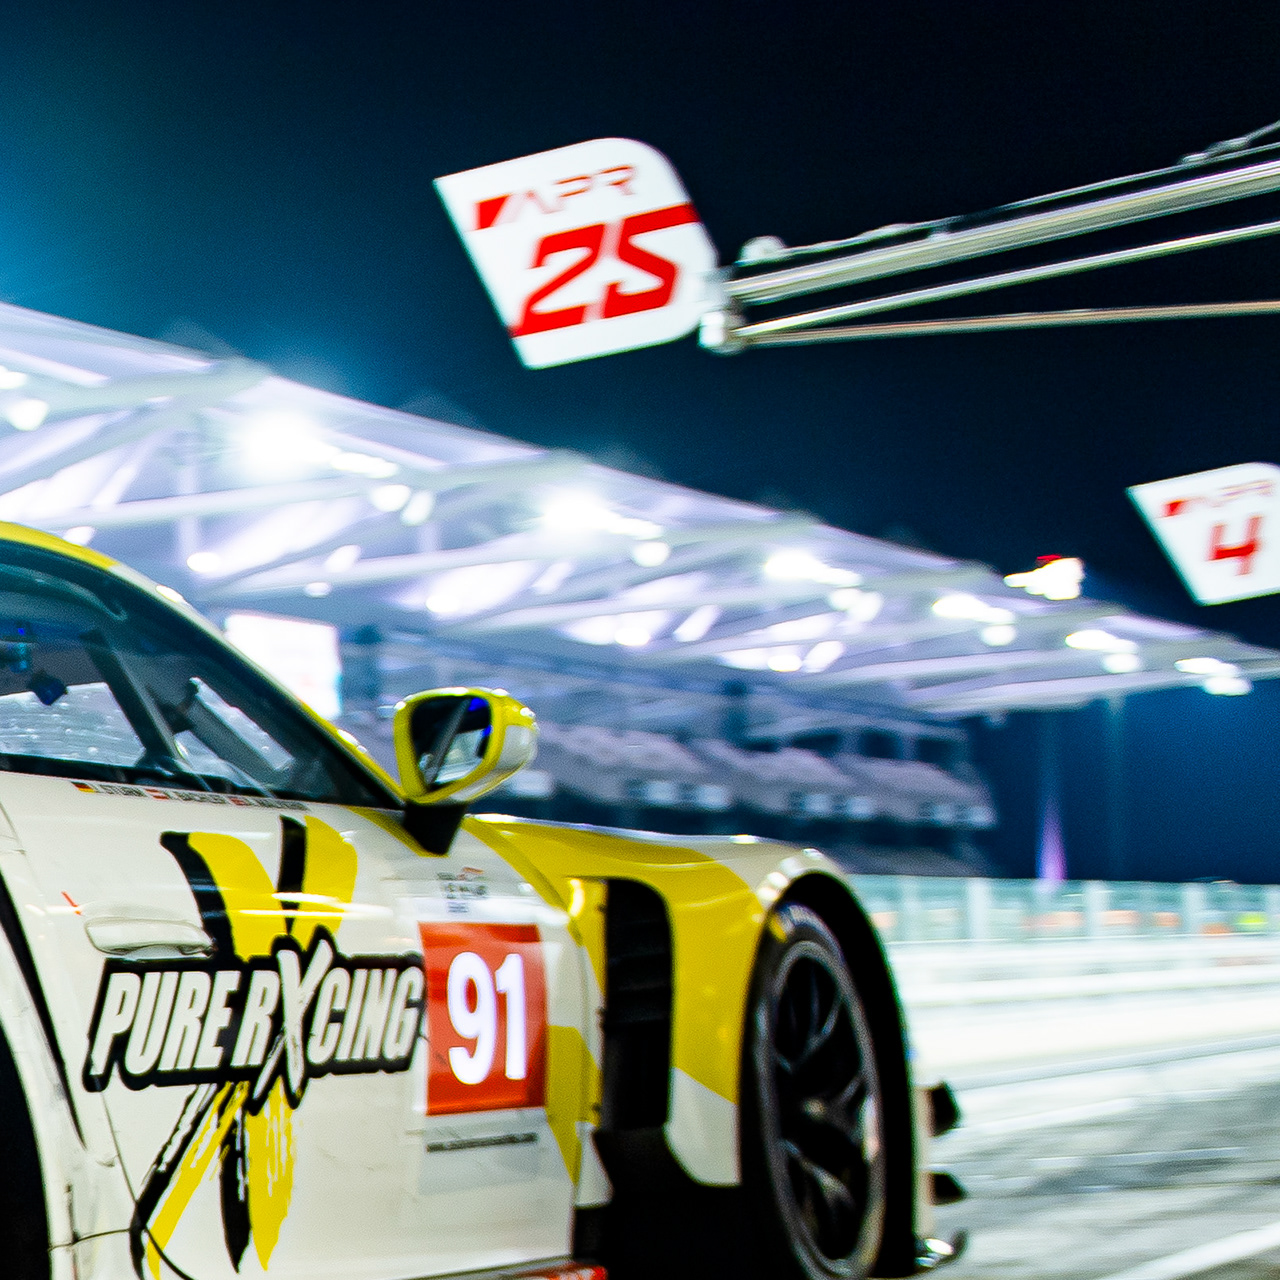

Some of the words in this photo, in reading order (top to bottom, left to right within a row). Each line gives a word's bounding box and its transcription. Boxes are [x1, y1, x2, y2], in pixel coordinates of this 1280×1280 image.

[1208, 514, 1264, 576] 4
[90, 969, 242, 1076] PURE
[448, 951, 527, 1085] 91
